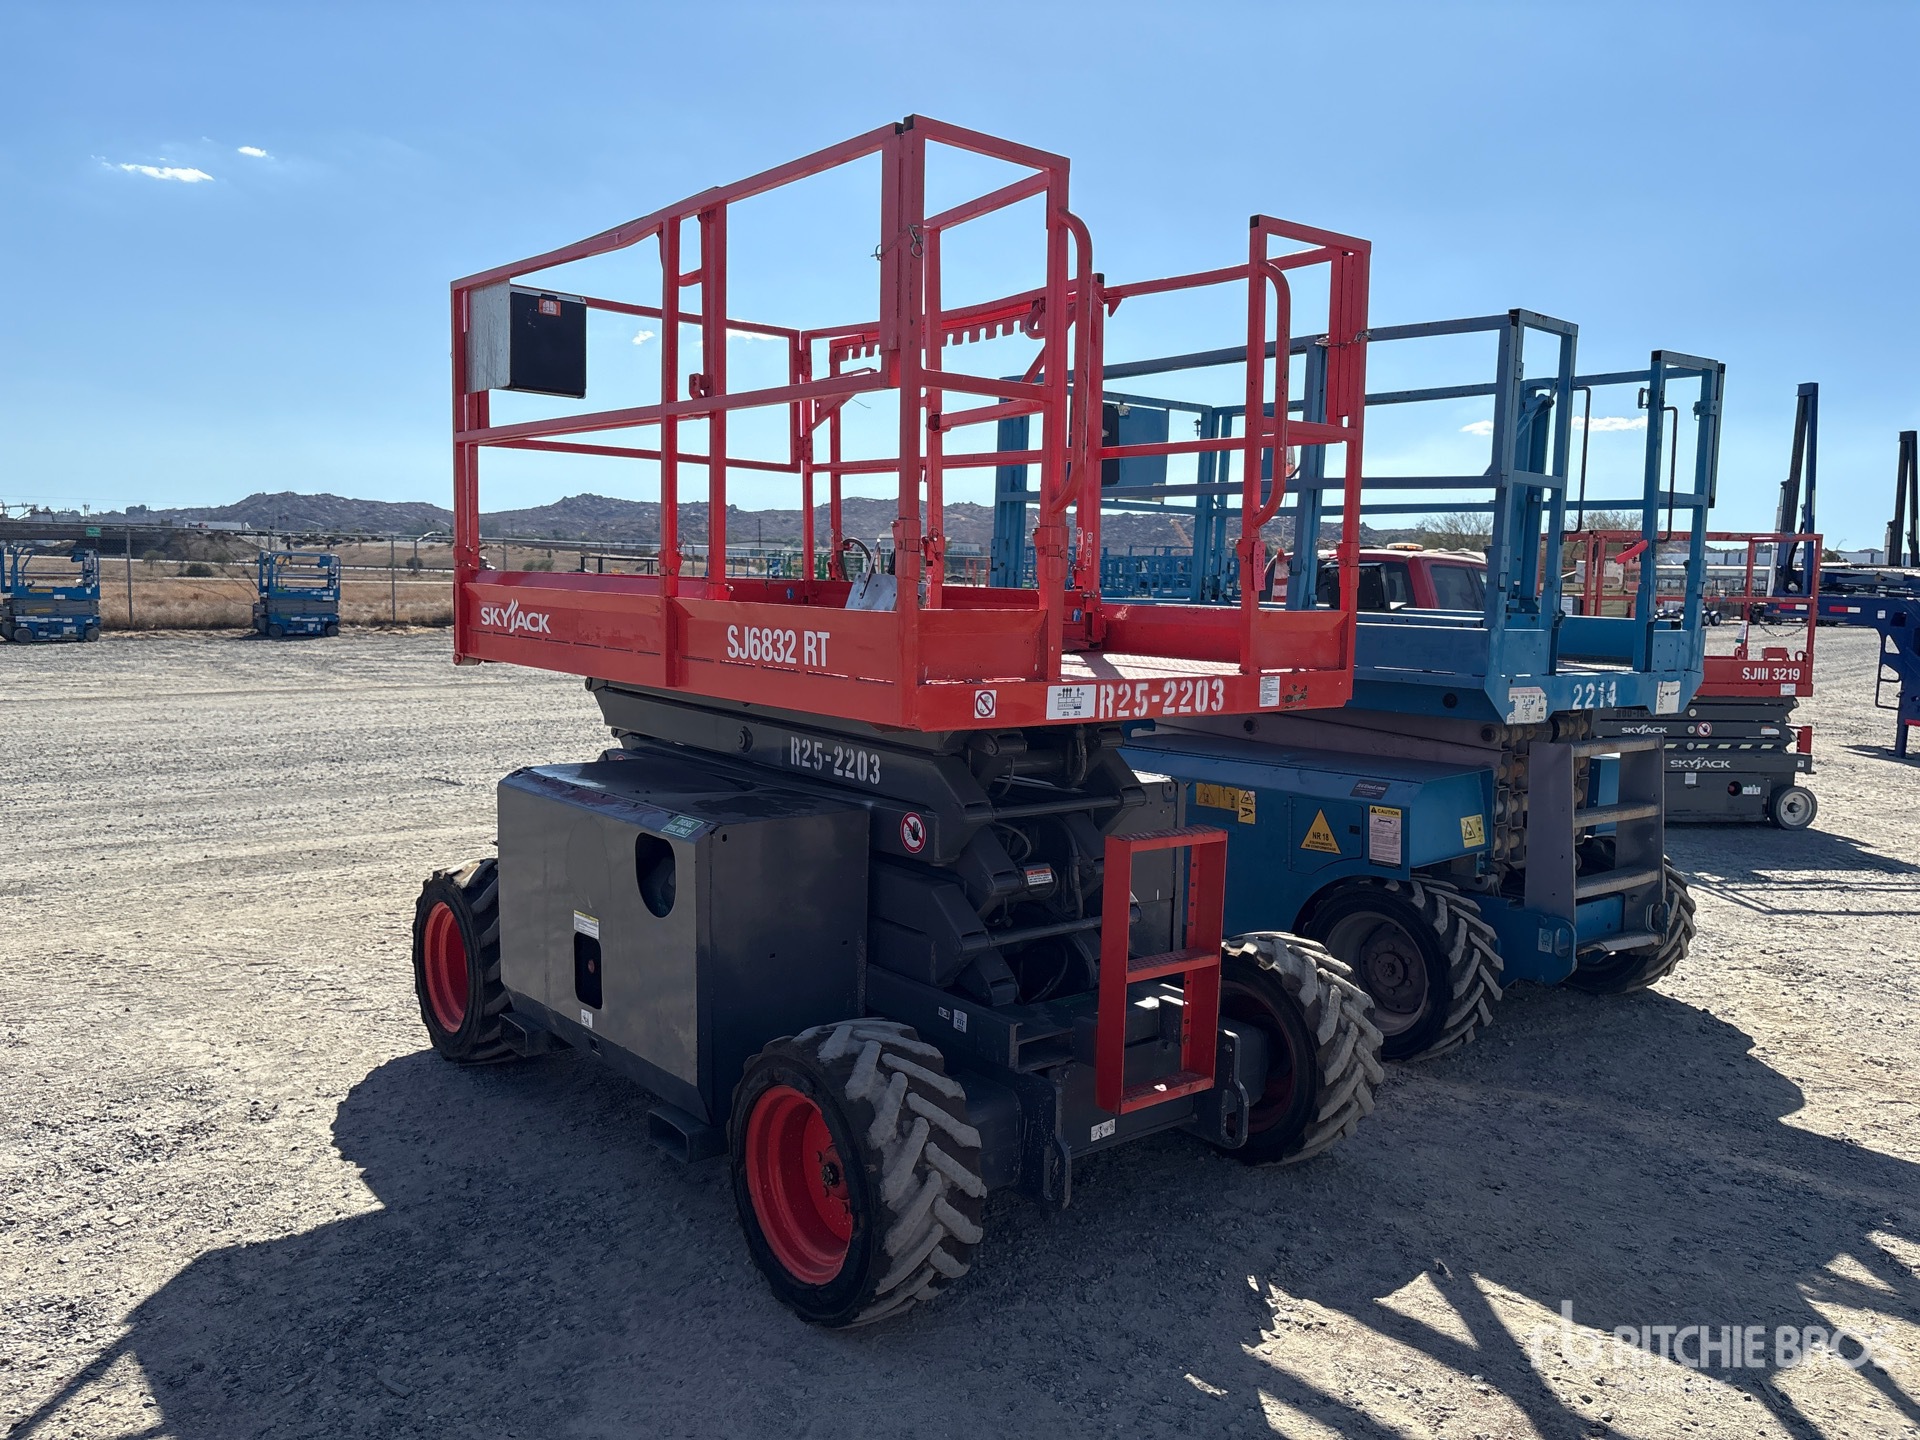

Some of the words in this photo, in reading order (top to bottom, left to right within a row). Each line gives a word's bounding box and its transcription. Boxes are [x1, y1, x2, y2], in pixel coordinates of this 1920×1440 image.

[480, 598, 551, 634] SKYJACK
[727, 624, 797, 665] SJ6832
[803, 630, 831, 667] RT
[1742, 667, 1769, 680] SJIII
[1772, 668, 1800, 681] 3219
[1099, 679, 1225, 719] R25-2203
[1572, 681, 1617, 710] 2214
[1621, 724, 1668, 735] SKYJACK
[790, 736, 881, 785] R25-2203
[1670, 757, 1731, 770] SKYJACK
[1312, 831, 1322, 841] NR
